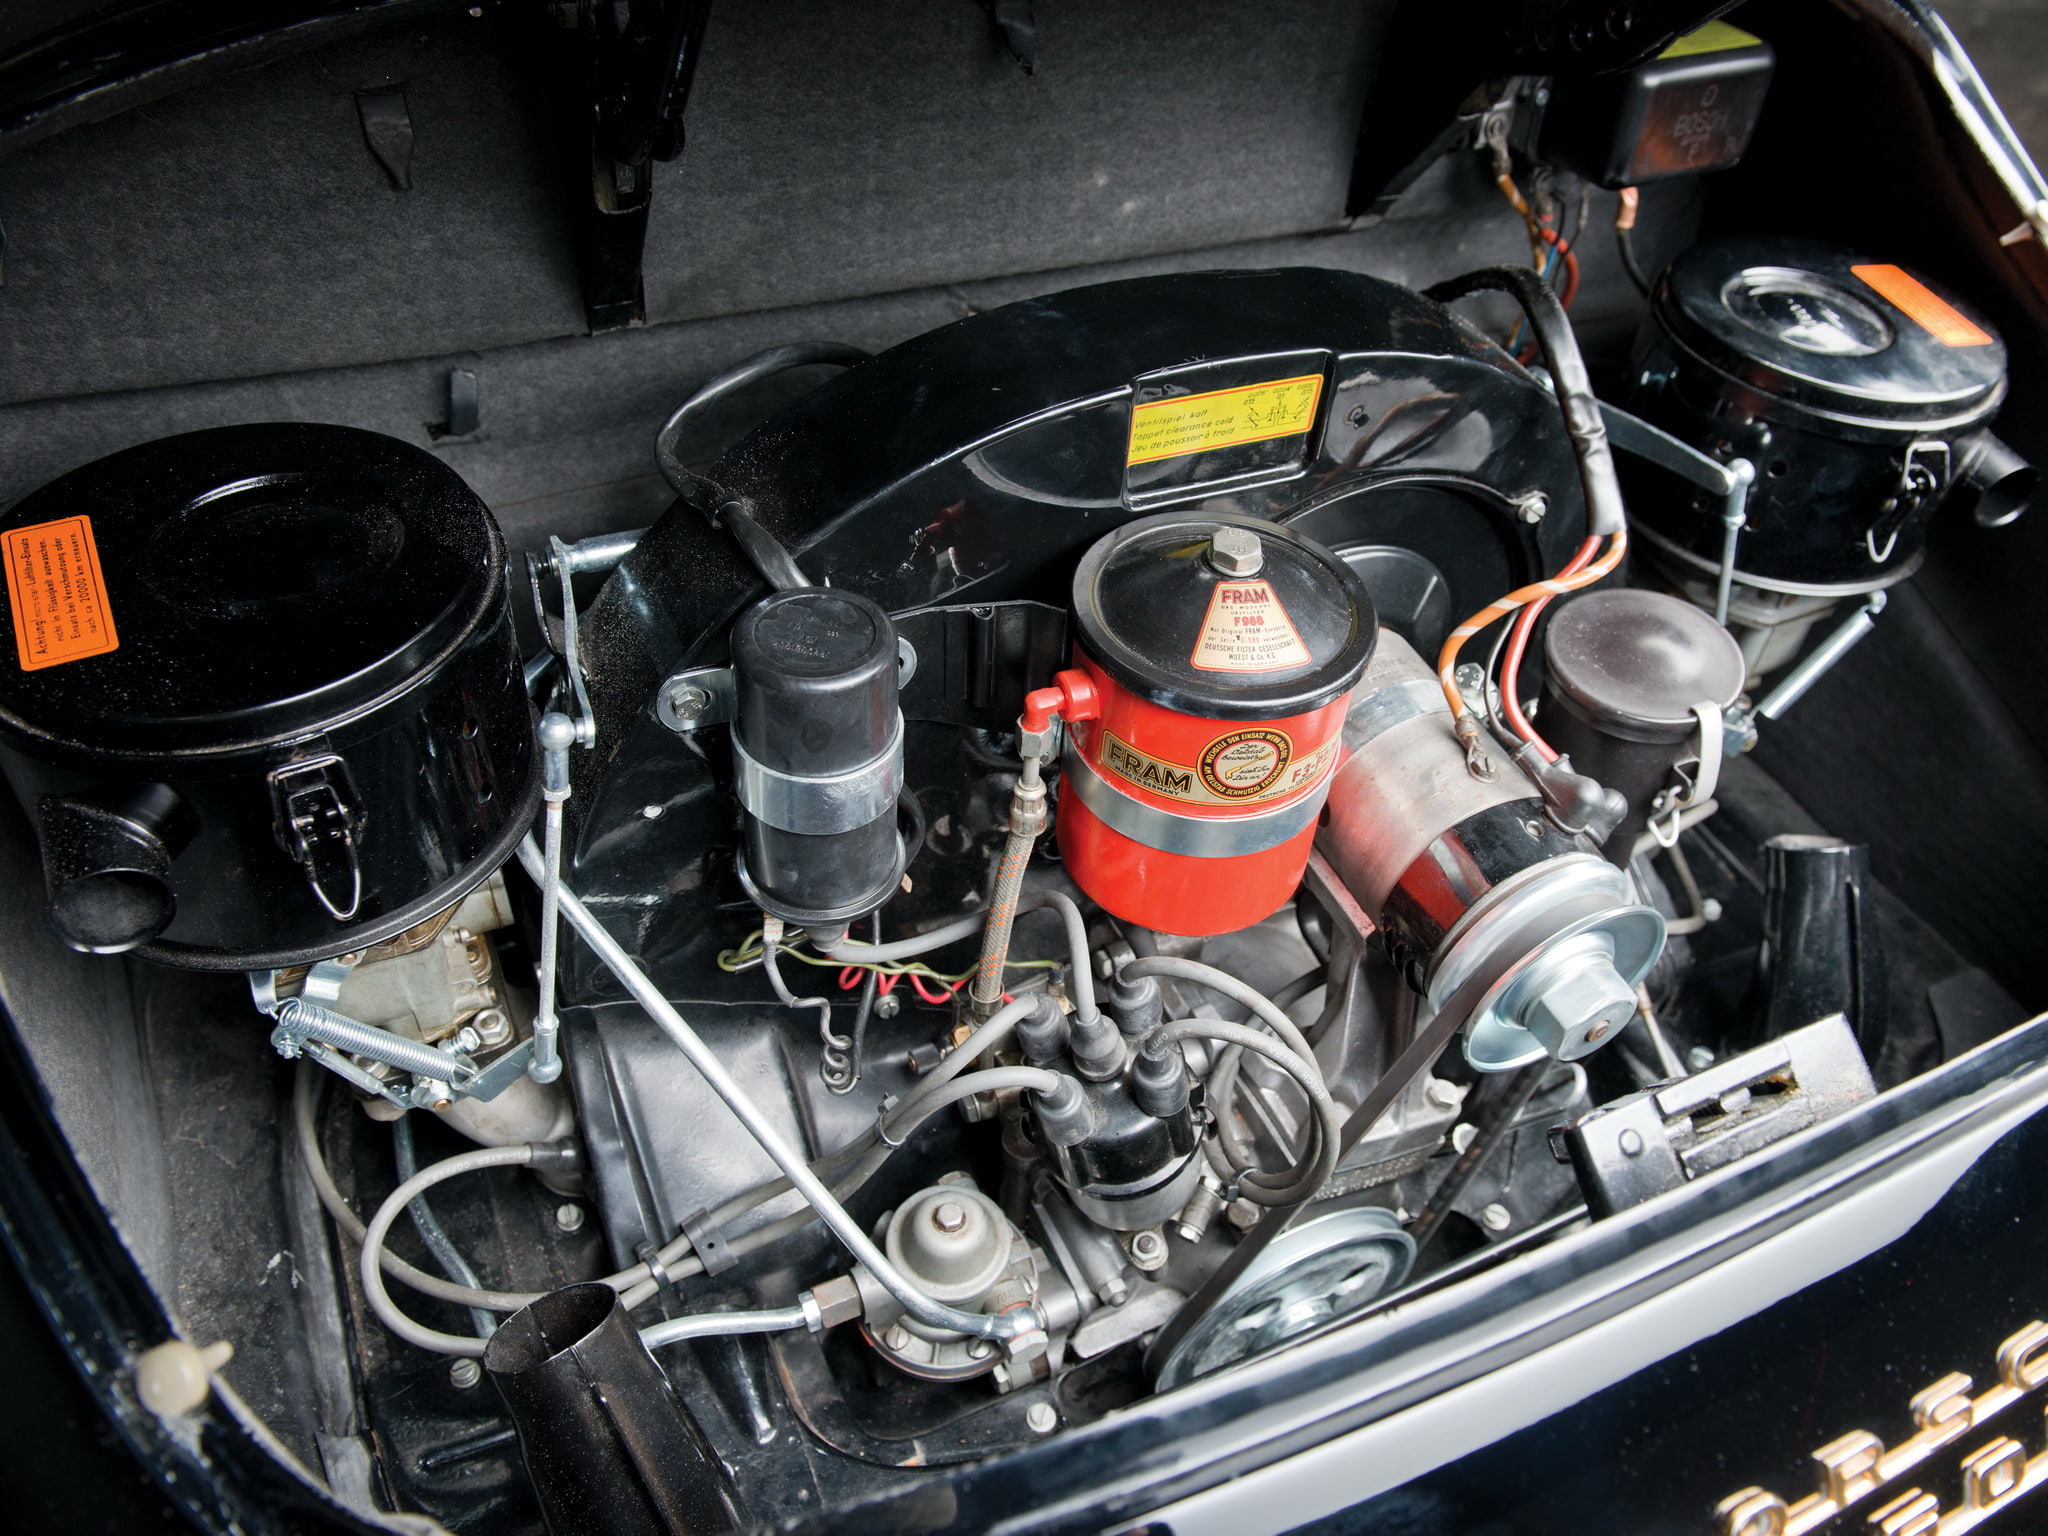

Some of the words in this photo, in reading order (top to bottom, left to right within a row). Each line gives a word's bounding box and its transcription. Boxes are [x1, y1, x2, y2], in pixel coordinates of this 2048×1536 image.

[1135, 413, 1186, 429] Ventilspiel
[1190, 409, 1208, 418] kalt
[1133, 430, 1164, 441] Tappet
[1166, 421, 1213, 435] clearance
[1215, 416, 1234, 426] cold
[1150, 440, 1162, 449] de
[53, 538, 64, 551] oder
[56, 552, 72, 602] Verschmutzung
[74, 564, 84, 576] km
[75, 578, 90, 603] 20000
[1221, 587, 1270, 604] FRAM
[65, 601, 76, 613] bei
[52, 614, 62, 622] in
[1234, 615, 1265, 627] F988
[54, 625, 65, 642] nicht
[70, 615, 81, 640] Einsatz
[30, 618, 48, 654] Achtung!
[1204, 643, 1234, 652] DEUTSCHE
[1229, 653, 1248, 661] WUEST
[1227, 735, 1240, 744] DEN
[1241, 732, 1265, 740] EINSATZ
[1108, 739, 1193, 793] FRAM
[1115, 765, 1132, 778] MADE
[1133, 775, 1141, 783] IN
[1143, 780, 1180, 796] GERMANY
[1226, 785, 1260, 796] SCHMUTZIG
[1303, 1070, 1326, 1100] BOSCH
